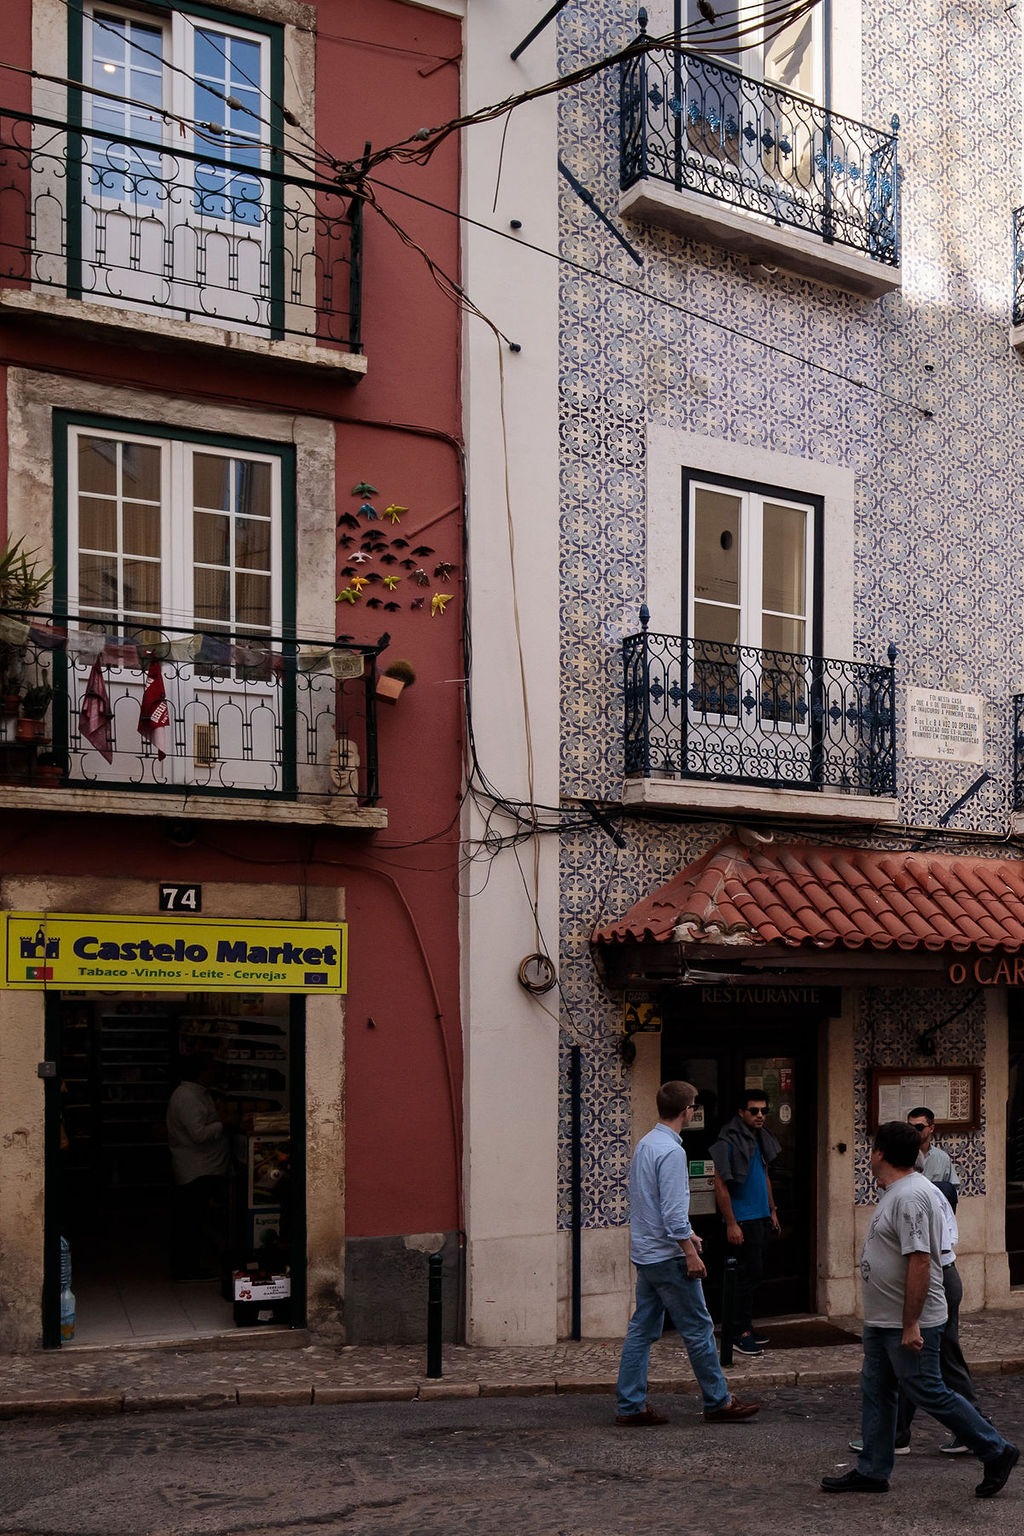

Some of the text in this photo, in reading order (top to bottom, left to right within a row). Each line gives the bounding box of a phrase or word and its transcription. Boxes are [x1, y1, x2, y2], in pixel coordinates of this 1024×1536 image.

[162, 888, 197, 910] 74
[73, 936, 337, 965] Castelo Market
[78, 968, 128, 978] Tabaco
[192, 969, 225, 979] Leite
[234, 970, 287, 981] Cervejas
[701, 987, 818, 1004] RESTAURANTE
